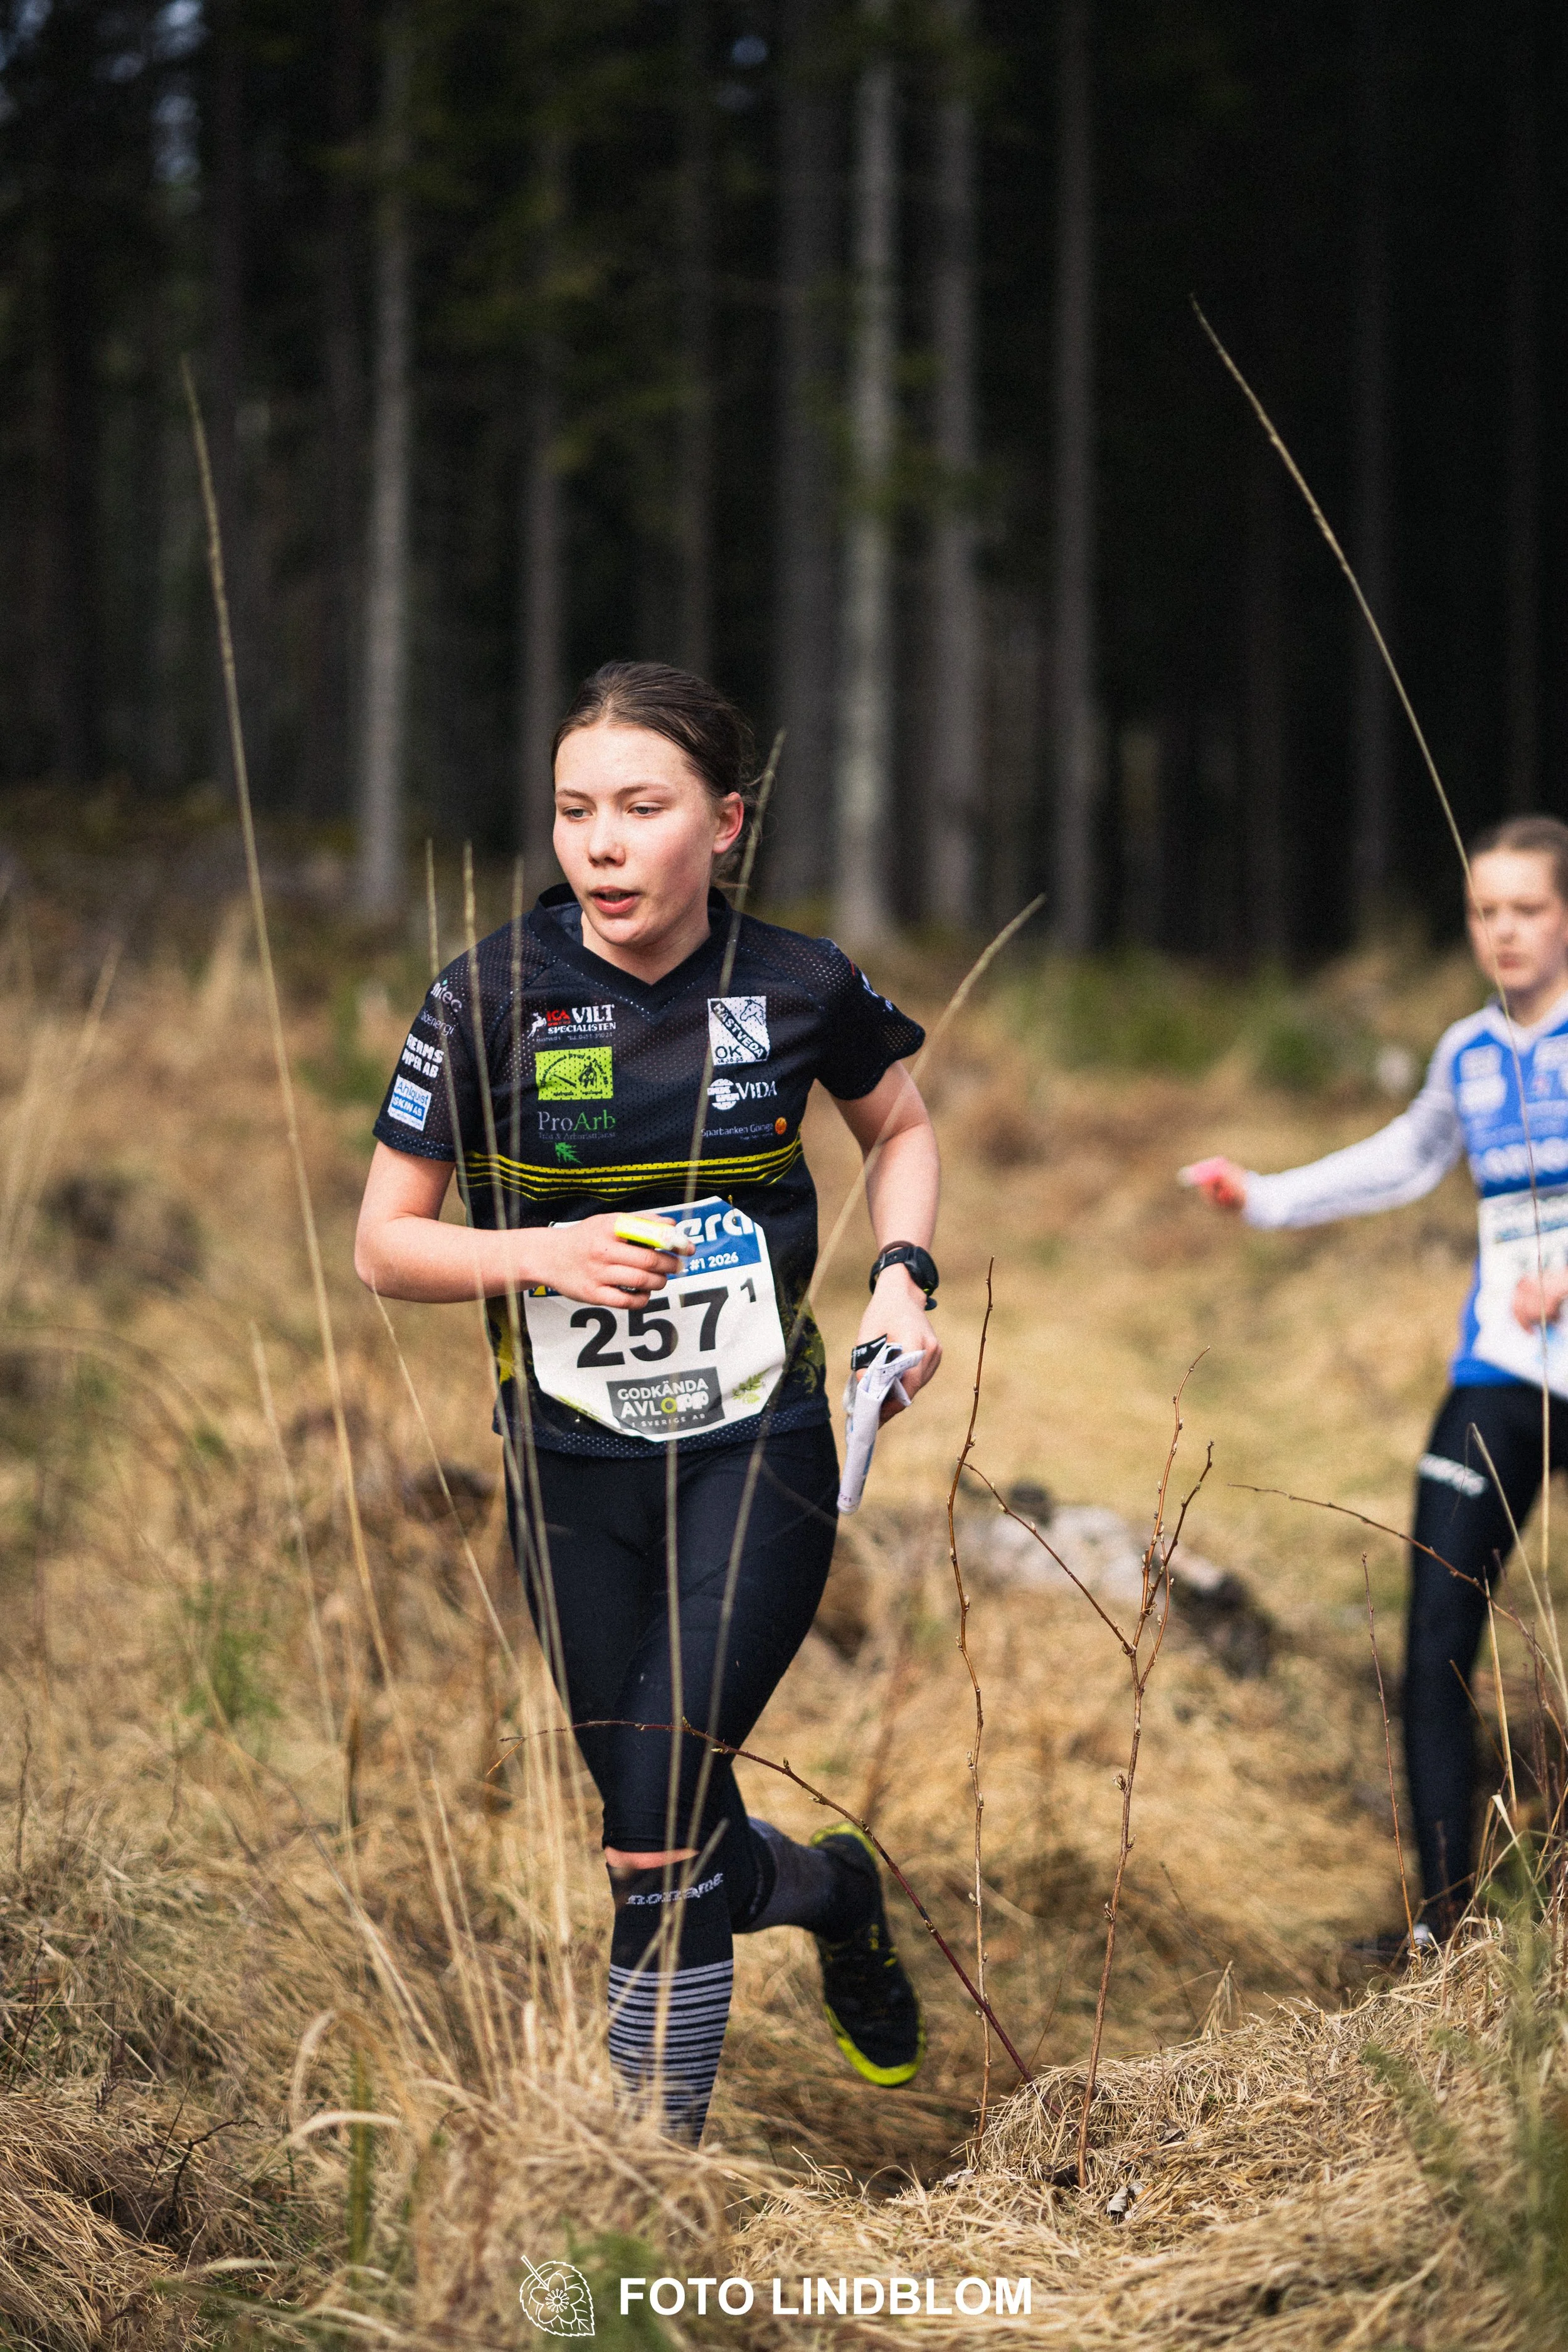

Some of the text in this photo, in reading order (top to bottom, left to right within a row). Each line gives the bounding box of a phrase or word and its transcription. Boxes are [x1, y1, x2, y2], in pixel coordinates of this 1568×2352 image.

[546, 1004, 615, 1024] ICA VILT
[548, 1022, 617, 1035] SPECIALISTEN
[714, 1045, 743, 1059] OK
[734, 1080, 778, 1100] VIDA
[537, 1109, 616, 1131] ProArb
[701, 1126, 749, 1137] Sparbanken
[707, 1252, 739, 1268] 2026
[569, 1277, 757, 1369] 257 1
[617, 1378, 709, 1401] GODKÄNDA
[620, 1391, 709, 1419] AVLOPP
[641, 1416, 687, 1428] SVERIGE
